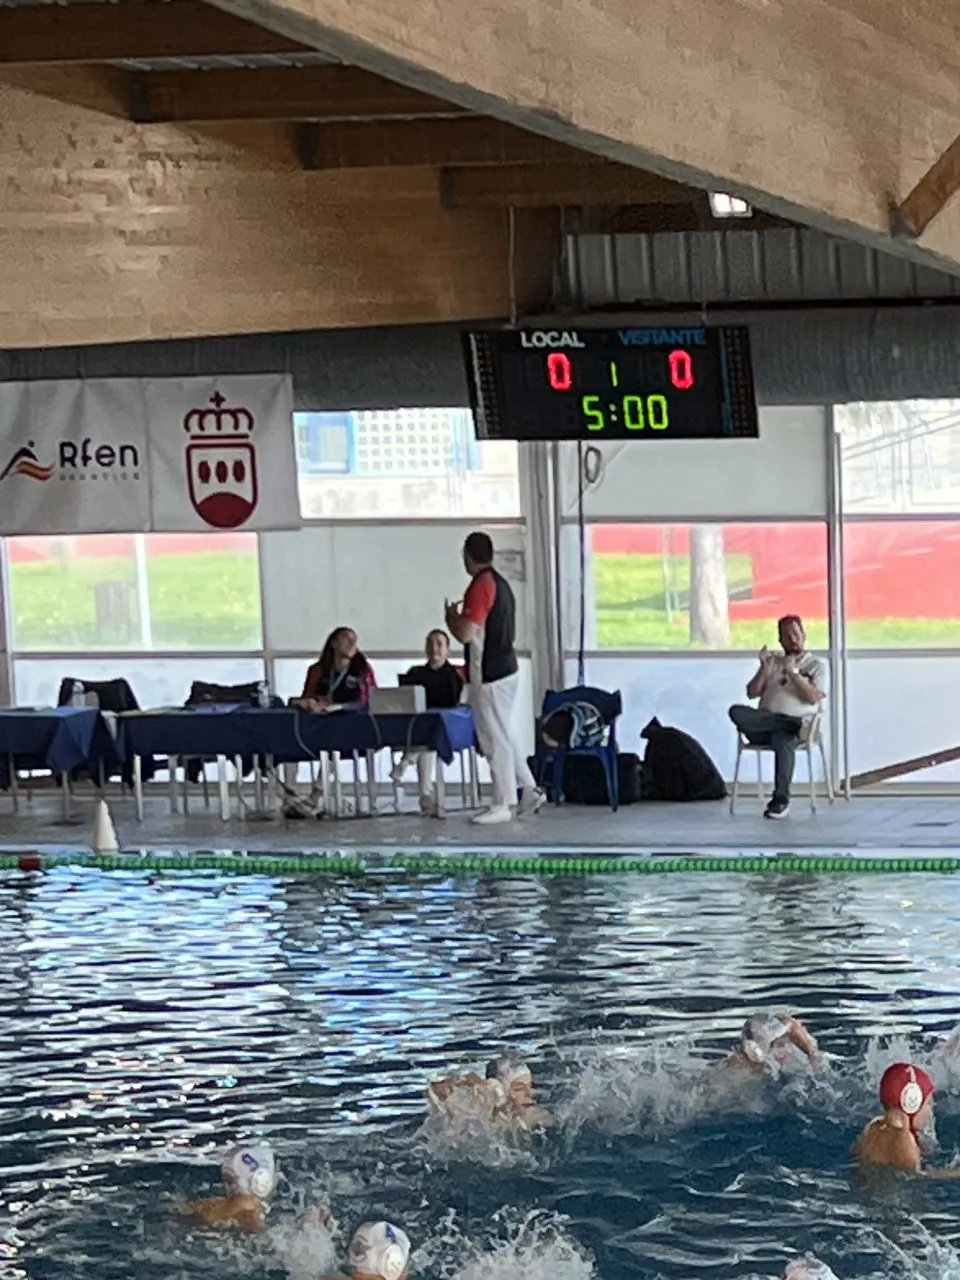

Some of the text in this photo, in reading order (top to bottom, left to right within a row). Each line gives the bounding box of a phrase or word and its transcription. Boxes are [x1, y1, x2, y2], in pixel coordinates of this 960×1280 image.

[520, 331, 585, 348] LOCAL
[618, 329, 708, 346] VISITANTE
[547, 352, 572, 390] 0
[610, 361, 618, 387] 1
[668, 349, 694, 389] 0
[582, 395, 668, 430] 5:00
[59, 437, 139, 468] Rfen
